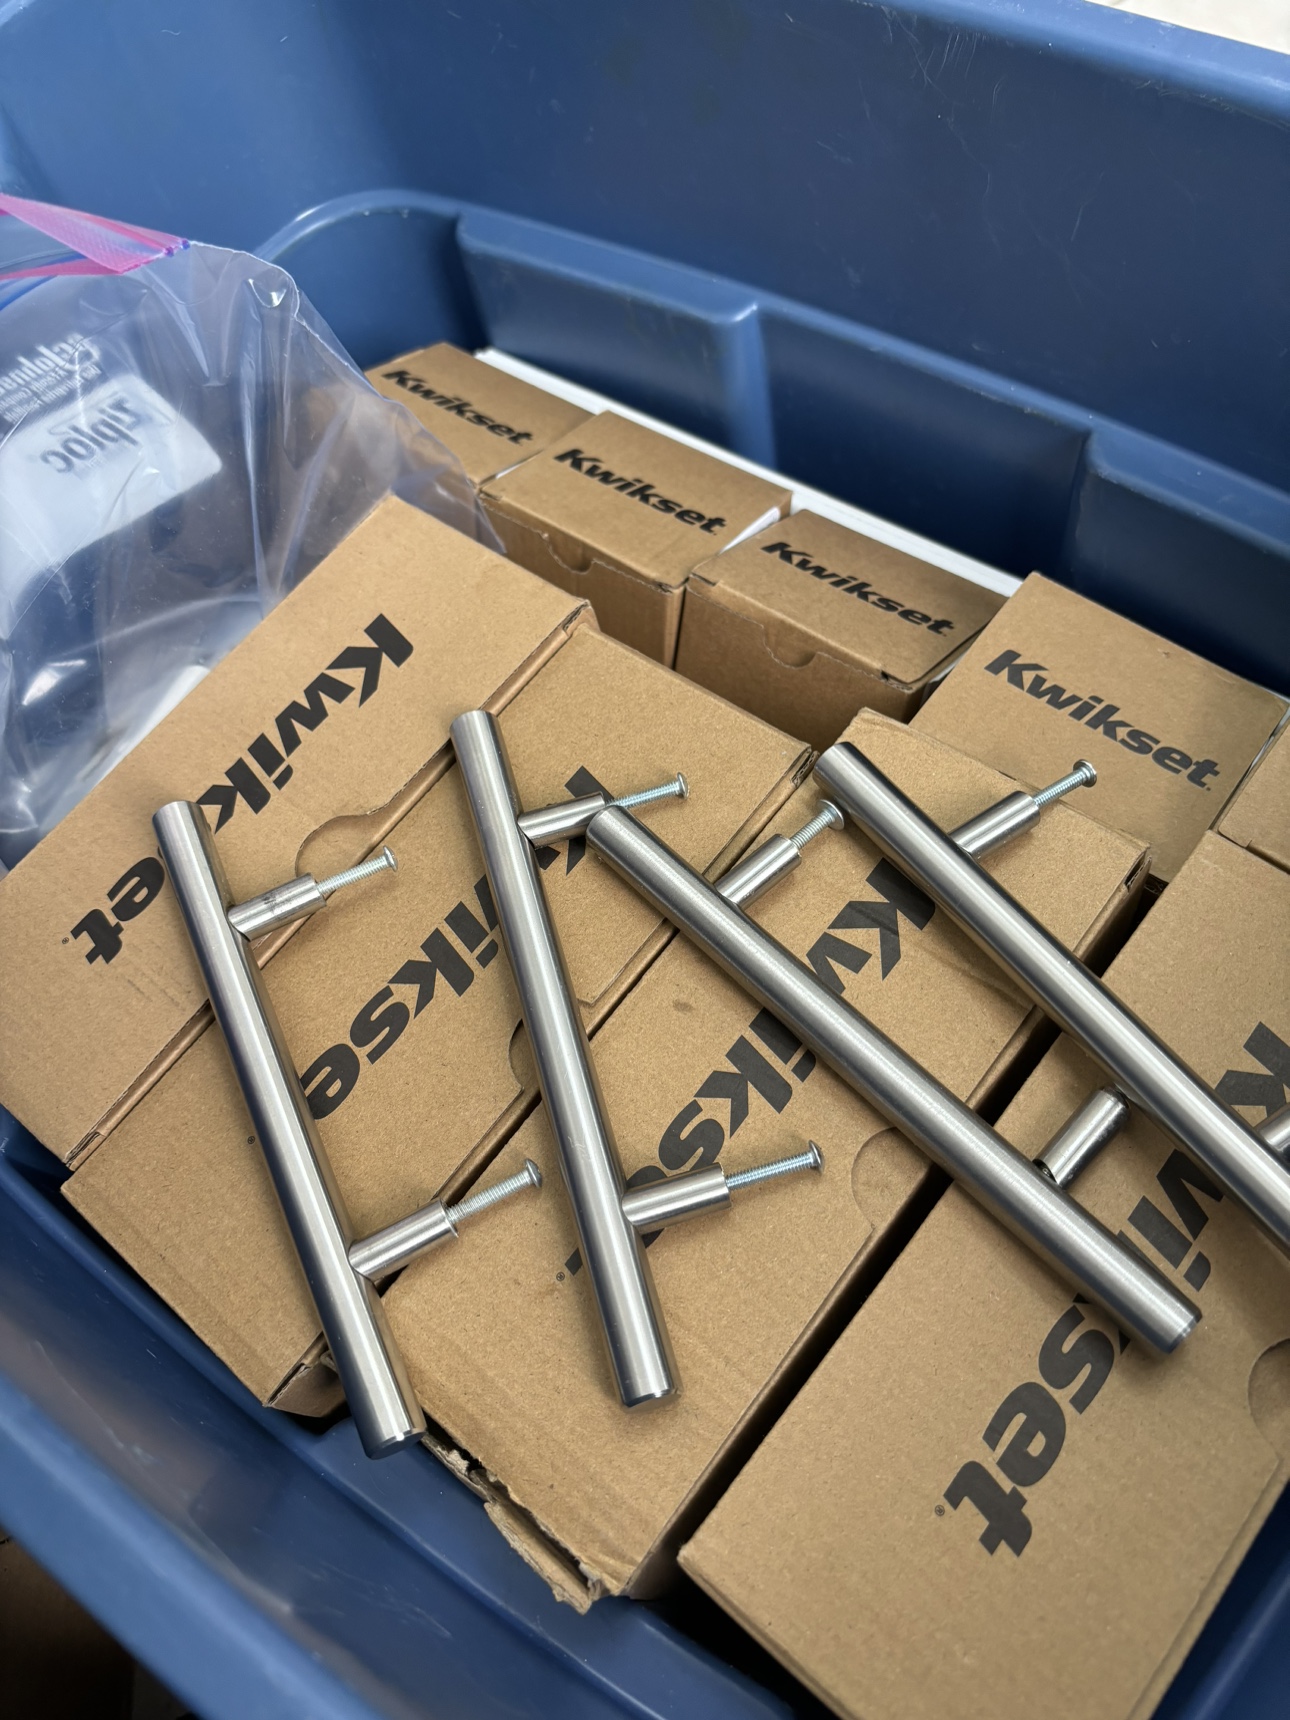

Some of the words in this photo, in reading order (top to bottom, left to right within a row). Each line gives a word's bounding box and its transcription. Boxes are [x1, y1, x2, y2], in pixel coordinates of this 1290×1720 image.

[382, 370, 534, 446] Kwikset
[554, 449, 728, 534] Kwikset
[760, 541, 954, 636] Kwikset
[984, 649, 1220, 789] Kwikset
[70, 613, 414, 965] Kwiket
